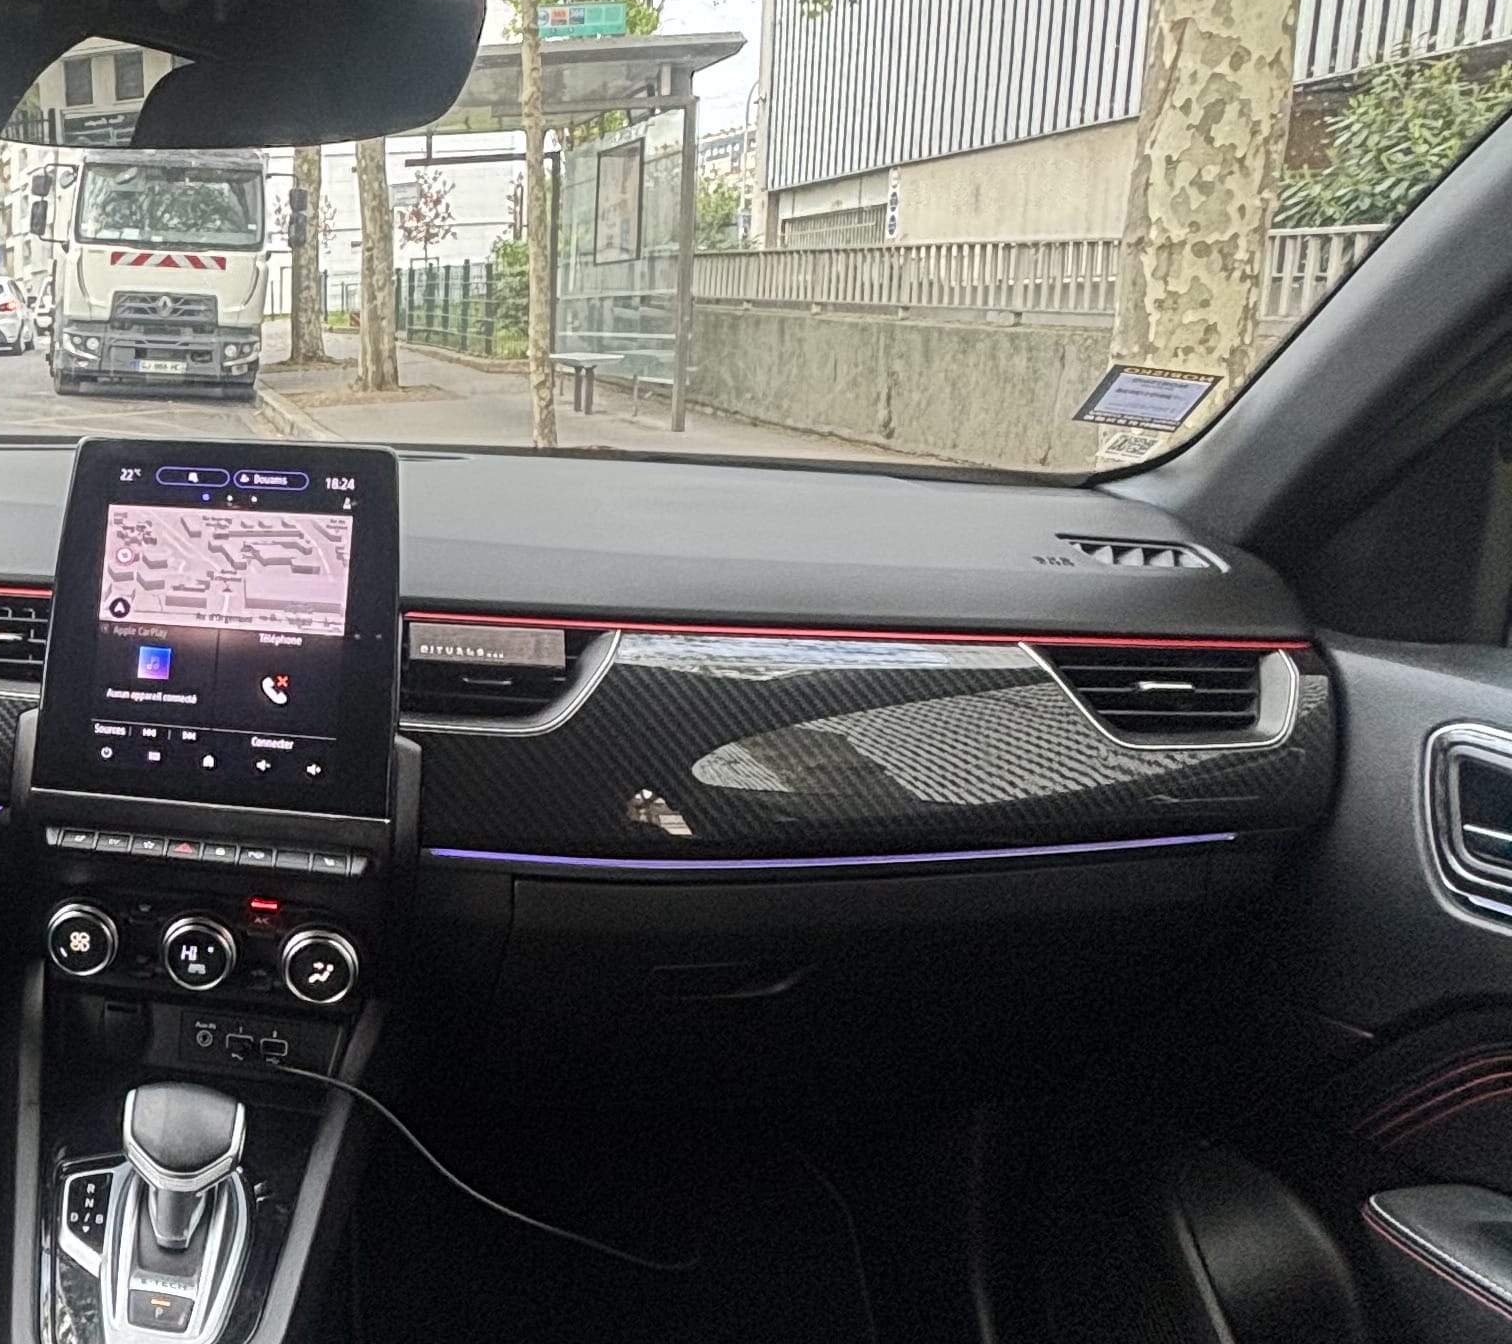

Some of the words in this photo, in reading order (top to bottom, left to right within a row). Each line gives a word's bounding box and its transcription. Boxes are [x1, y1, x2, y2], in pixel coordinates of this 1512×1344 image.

[113, 625, 136, 637] Apple
[94, 723, 126, 736] Sources
[86, 1183, 96, 1194] R
[84, 1197, 94, 1208] N
[155, 1307, 163, 1318] P
